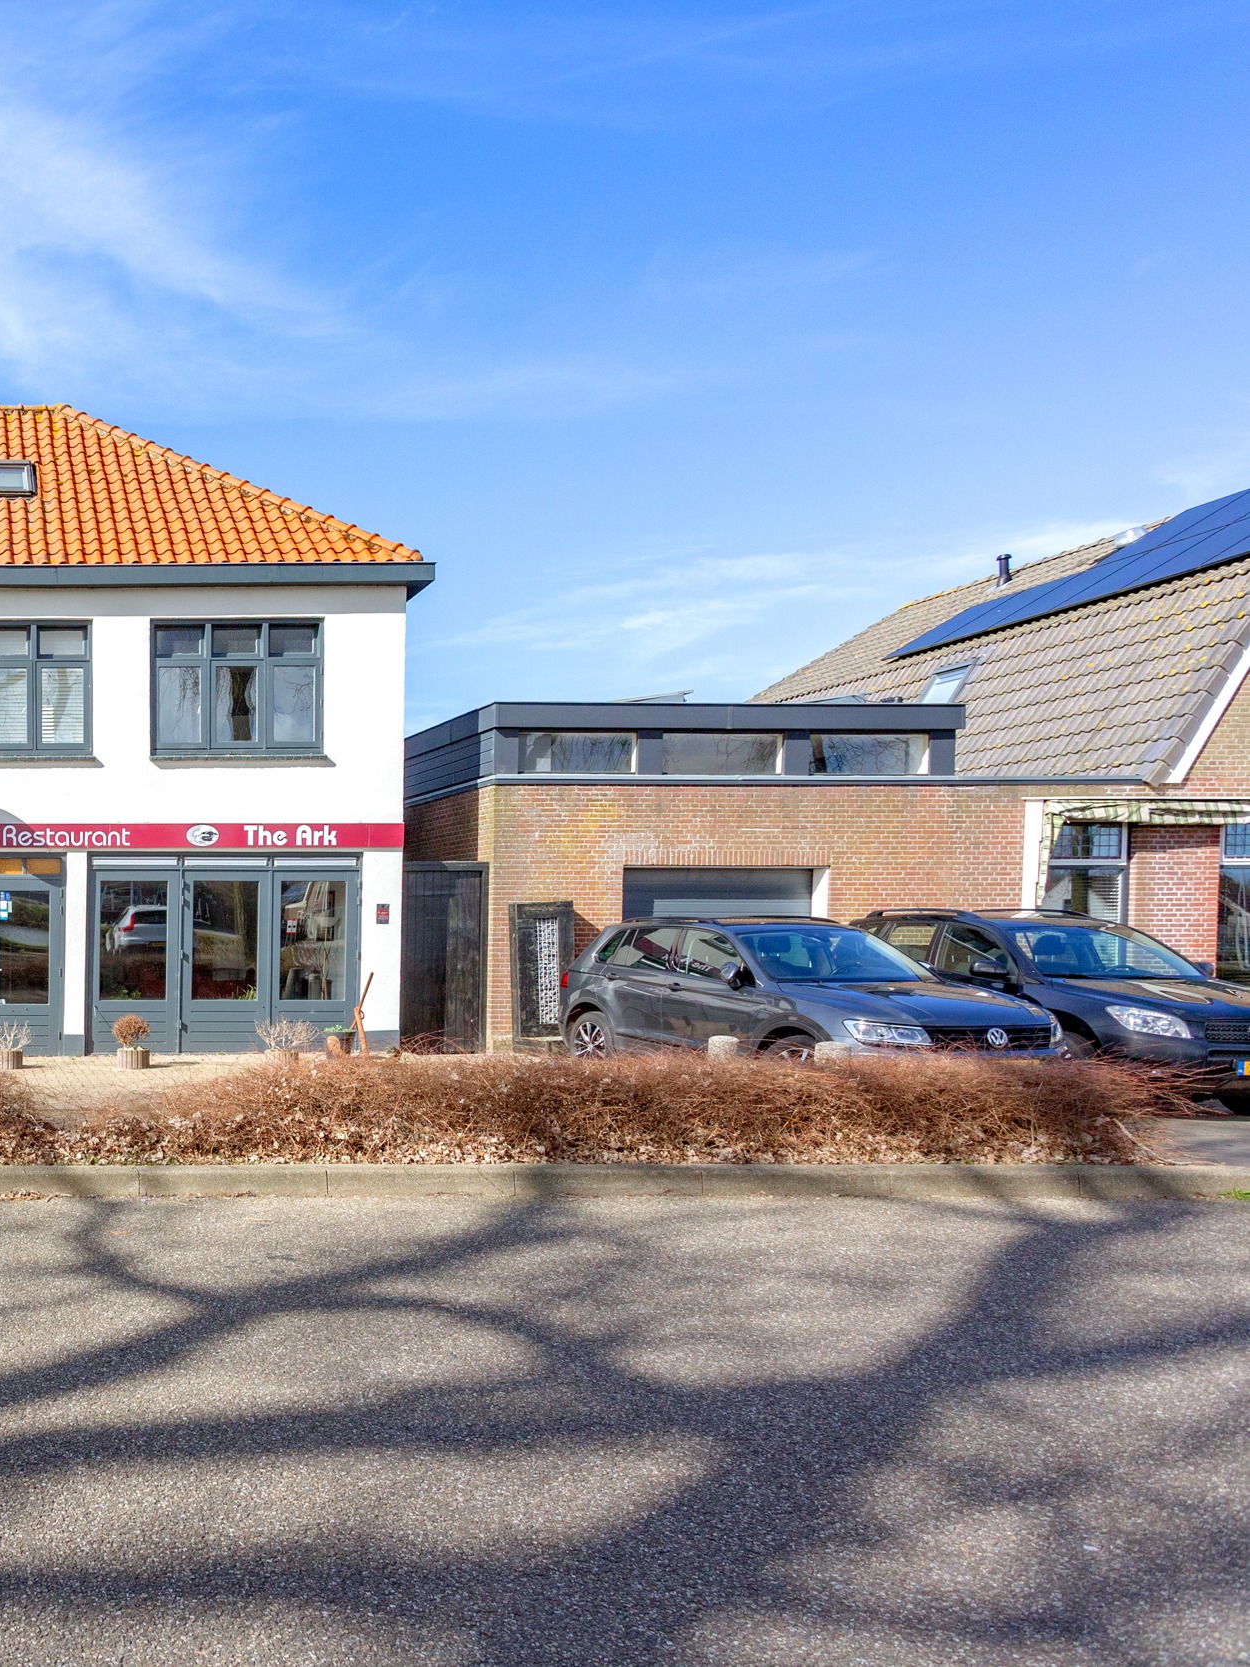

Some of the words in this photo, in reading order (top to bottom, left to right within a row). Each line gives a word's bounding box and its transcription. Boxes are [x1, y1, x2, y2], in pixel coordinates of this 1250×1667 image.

[2, 825, 131, 847] Restaurant
[243, 825, 289, 847] The
[295, 824, 338, 847] Ark
[987, 1027, 1008, 1048] VW
